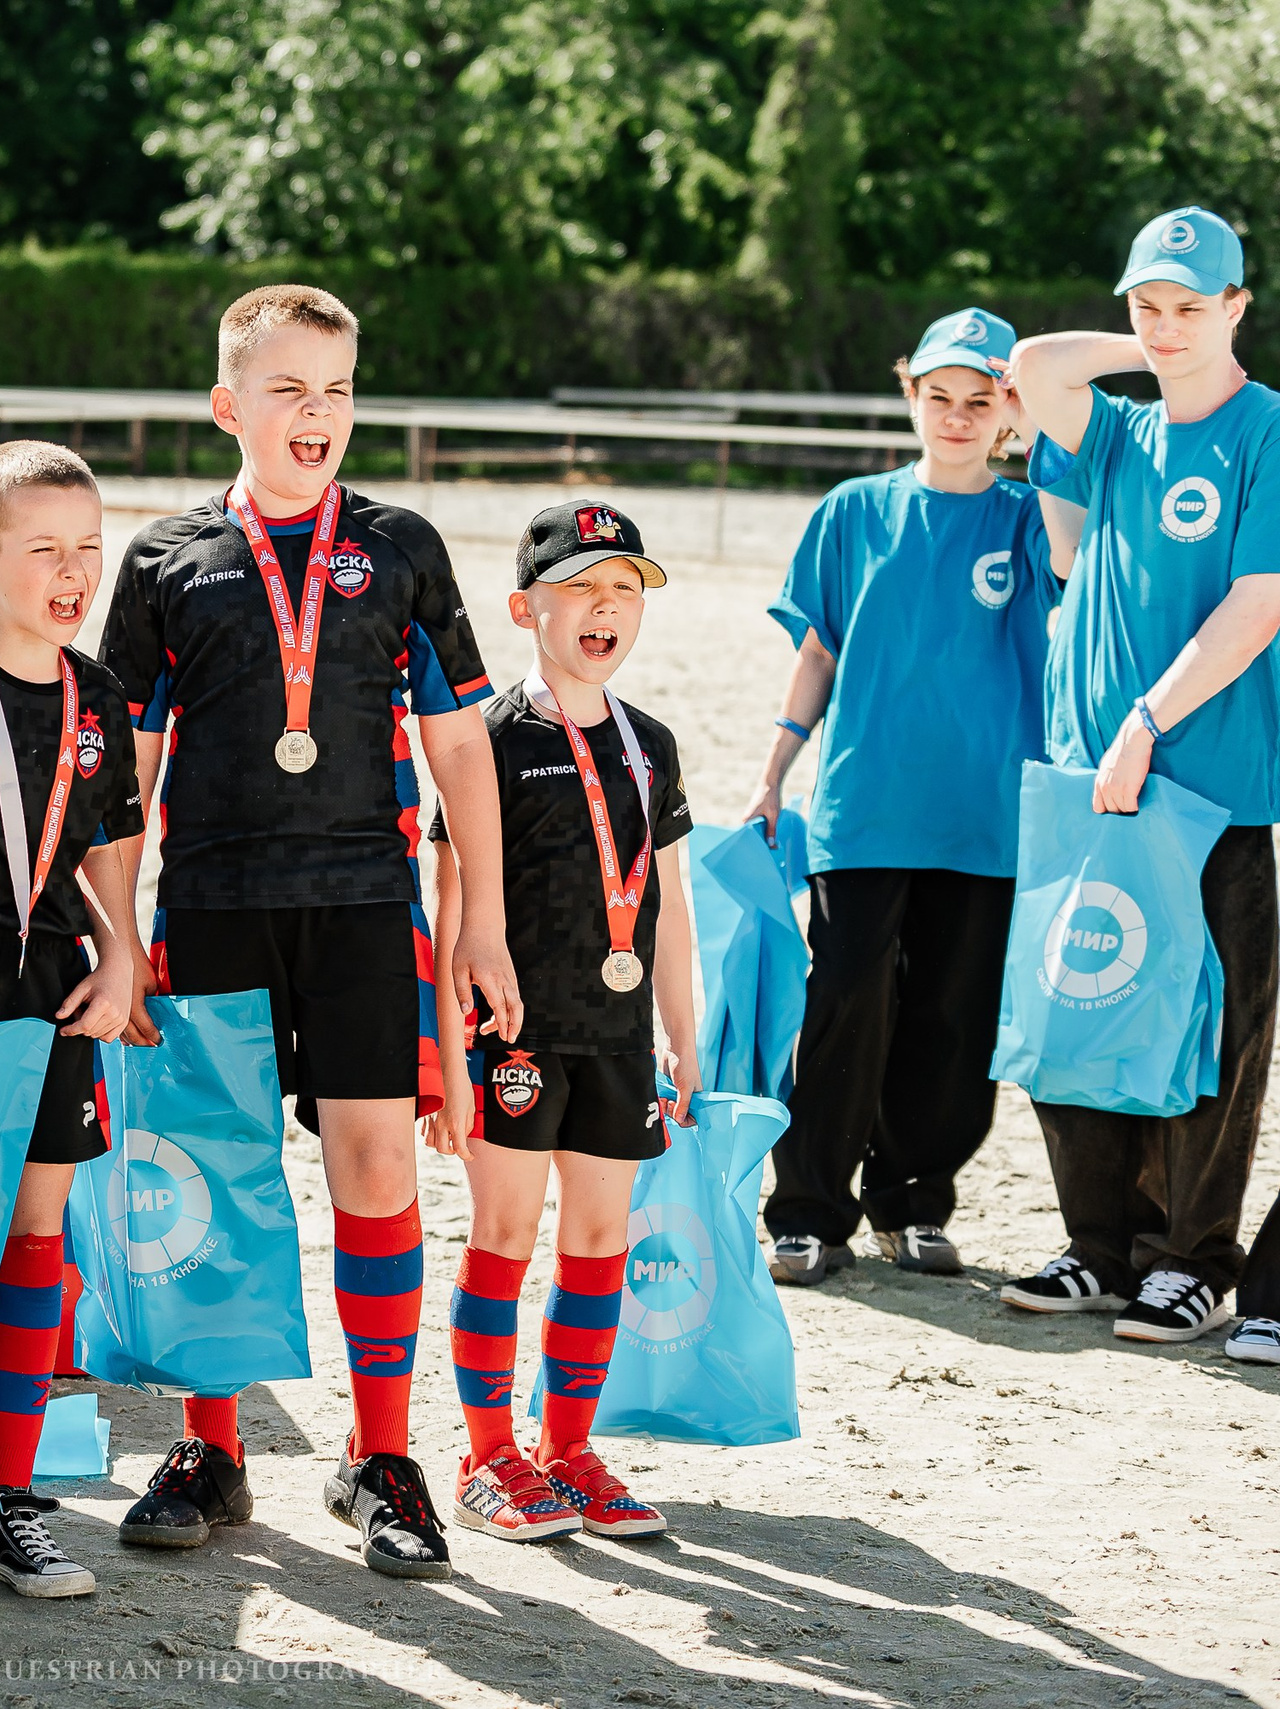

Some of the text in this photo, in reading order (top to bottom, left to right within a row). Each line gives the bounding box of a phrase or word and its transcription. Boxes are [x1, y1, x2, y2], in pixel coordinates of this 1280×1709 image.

[1176, 501, 1205, 512] МИР
[195, 569, 246, 588] PATRICK
[267, 575, 296, 649] МОСКОВСКИЙ СПОРТ
[300, 576, 322, 654] МОСКОВСКИЙ СПОРТ
[532, 764, 578, 778] PATRICK
[41, 780, 68, 863] МОСКОВСКИЙ СПОРТ
[592, 800, 617, 878] МОСКОВСКИЙ СПОРТ
[1063, 927, 1119, 952] МИР
[1036, 967, 1140, 1011] СМОТРИ НА 18 КНОПКЕ
[491, 1068, 544, 1088] ЦСКА
[126, 1188, 176, 1213] ИР
[104, 1237, 219, 1289] СМОТ НА 18 КНОПКЕ
[633, 1259, 696, 1283] МИР
[641, 1344, 660, 1355] НА
[663, 1342, 678, 1354] 18
